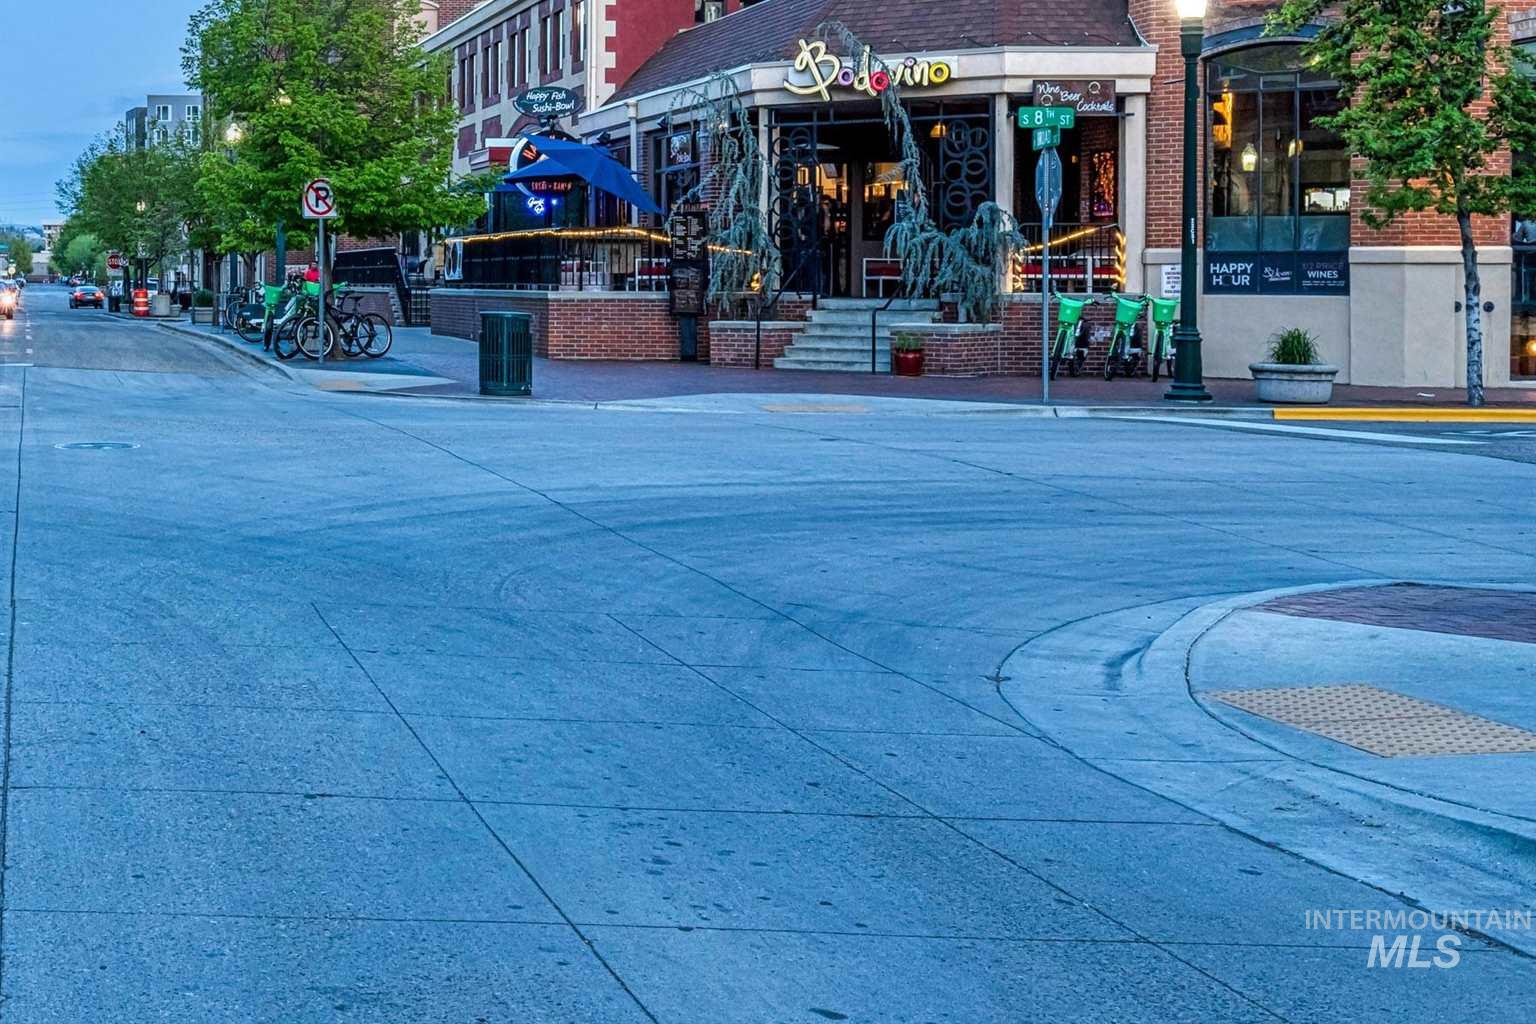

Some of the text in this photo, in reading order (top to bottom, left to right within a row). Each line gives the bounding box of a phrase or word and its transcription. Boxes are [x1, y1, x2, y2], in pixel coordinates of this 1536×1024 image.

[783, 38, 951, 102] Bodovino
[526, 90, 566, 102] Happy Fish
[1077, 98, 1114, 112] Cocktails
[1022, 114, 1029, 125] S
[1060, 115, 1071, 125] ST
[1209, 262, 1254, 274] HAPPY
[1307, 270, 1339, 279] WINES
